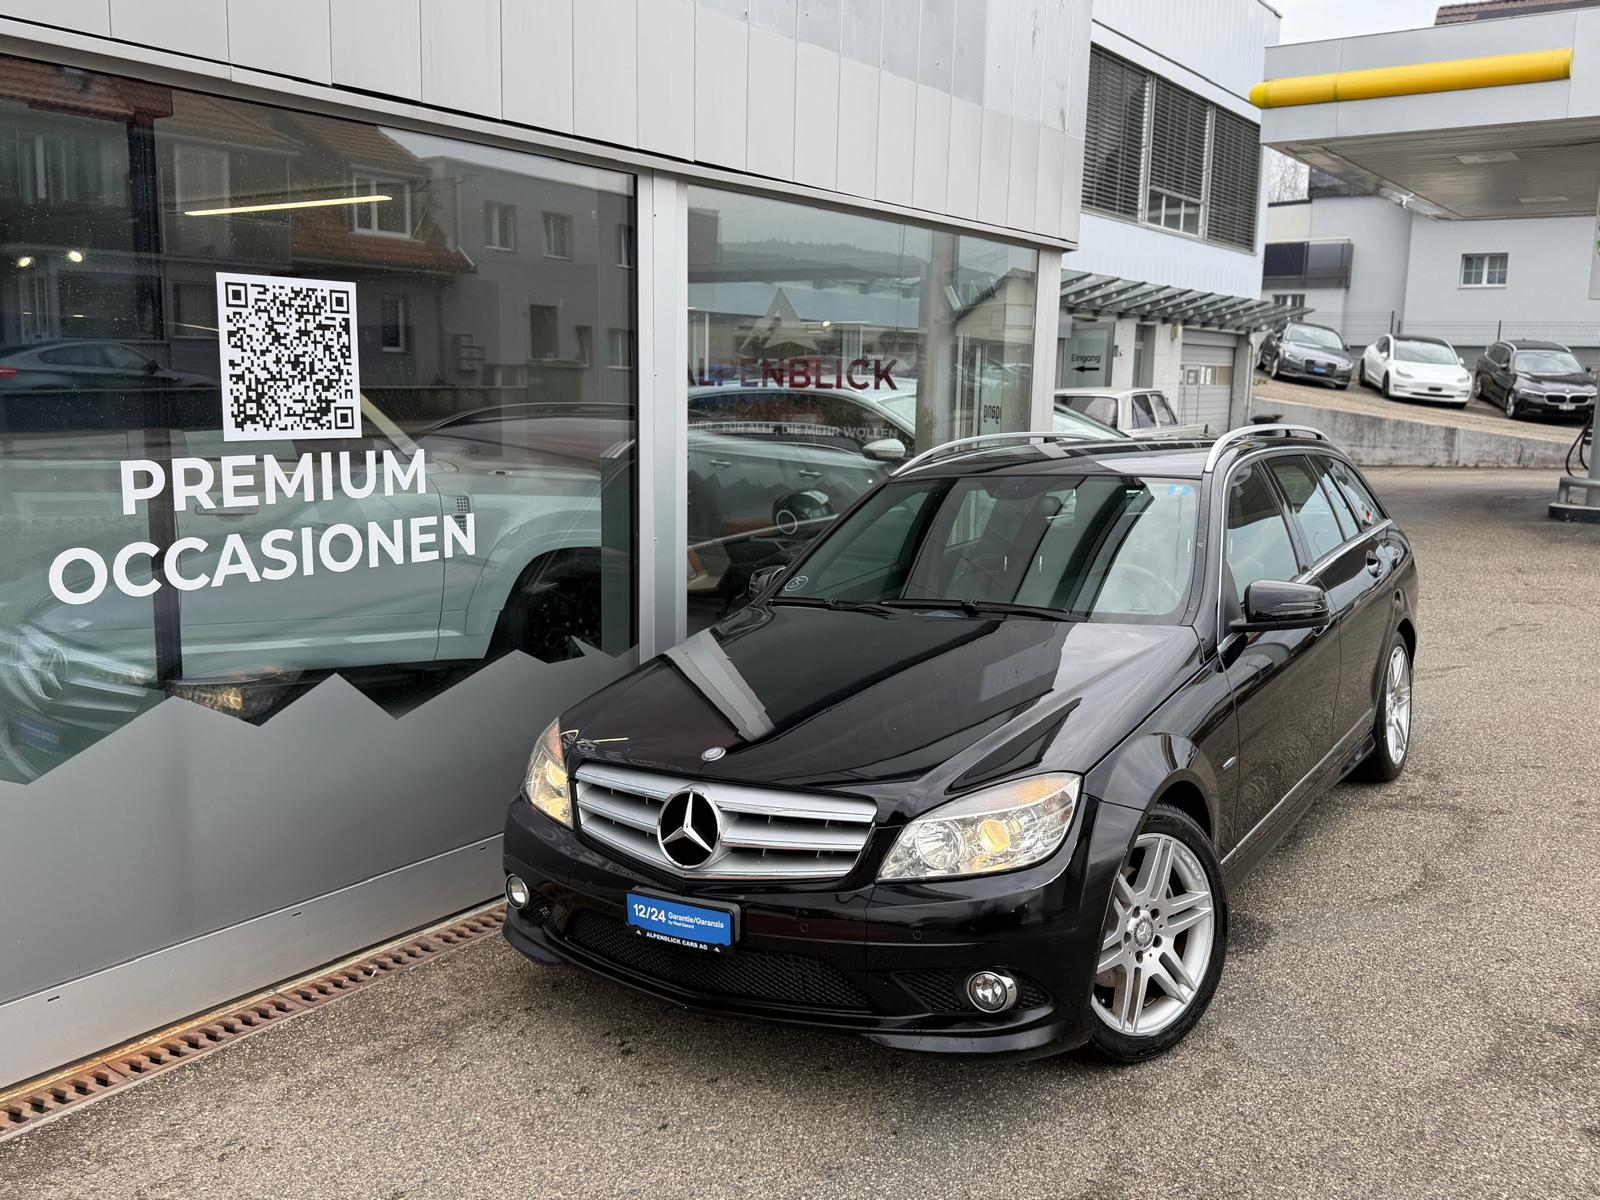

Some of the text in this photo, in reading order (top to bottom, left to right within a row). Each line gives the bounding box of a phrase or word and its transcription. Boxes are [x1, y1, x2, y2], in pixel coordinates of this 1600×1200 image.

[1071, 353, 1101, 364] Eingang
[746, 421, 778, 436] ALLE,
[782, 422, 802, 435] DIE
[804, 424, 840, 437] MEHR
[842, 426, 899, 439] WOLLEN
[120, 448, 427, 516] PREMIUM
[48, 512, 476, 605] OCCASIONEN
[633, 903, 725, 929] 12/24 Garantie/Garanzia
[646, 931, 709, 951] ALPENBLICK CARS AG
